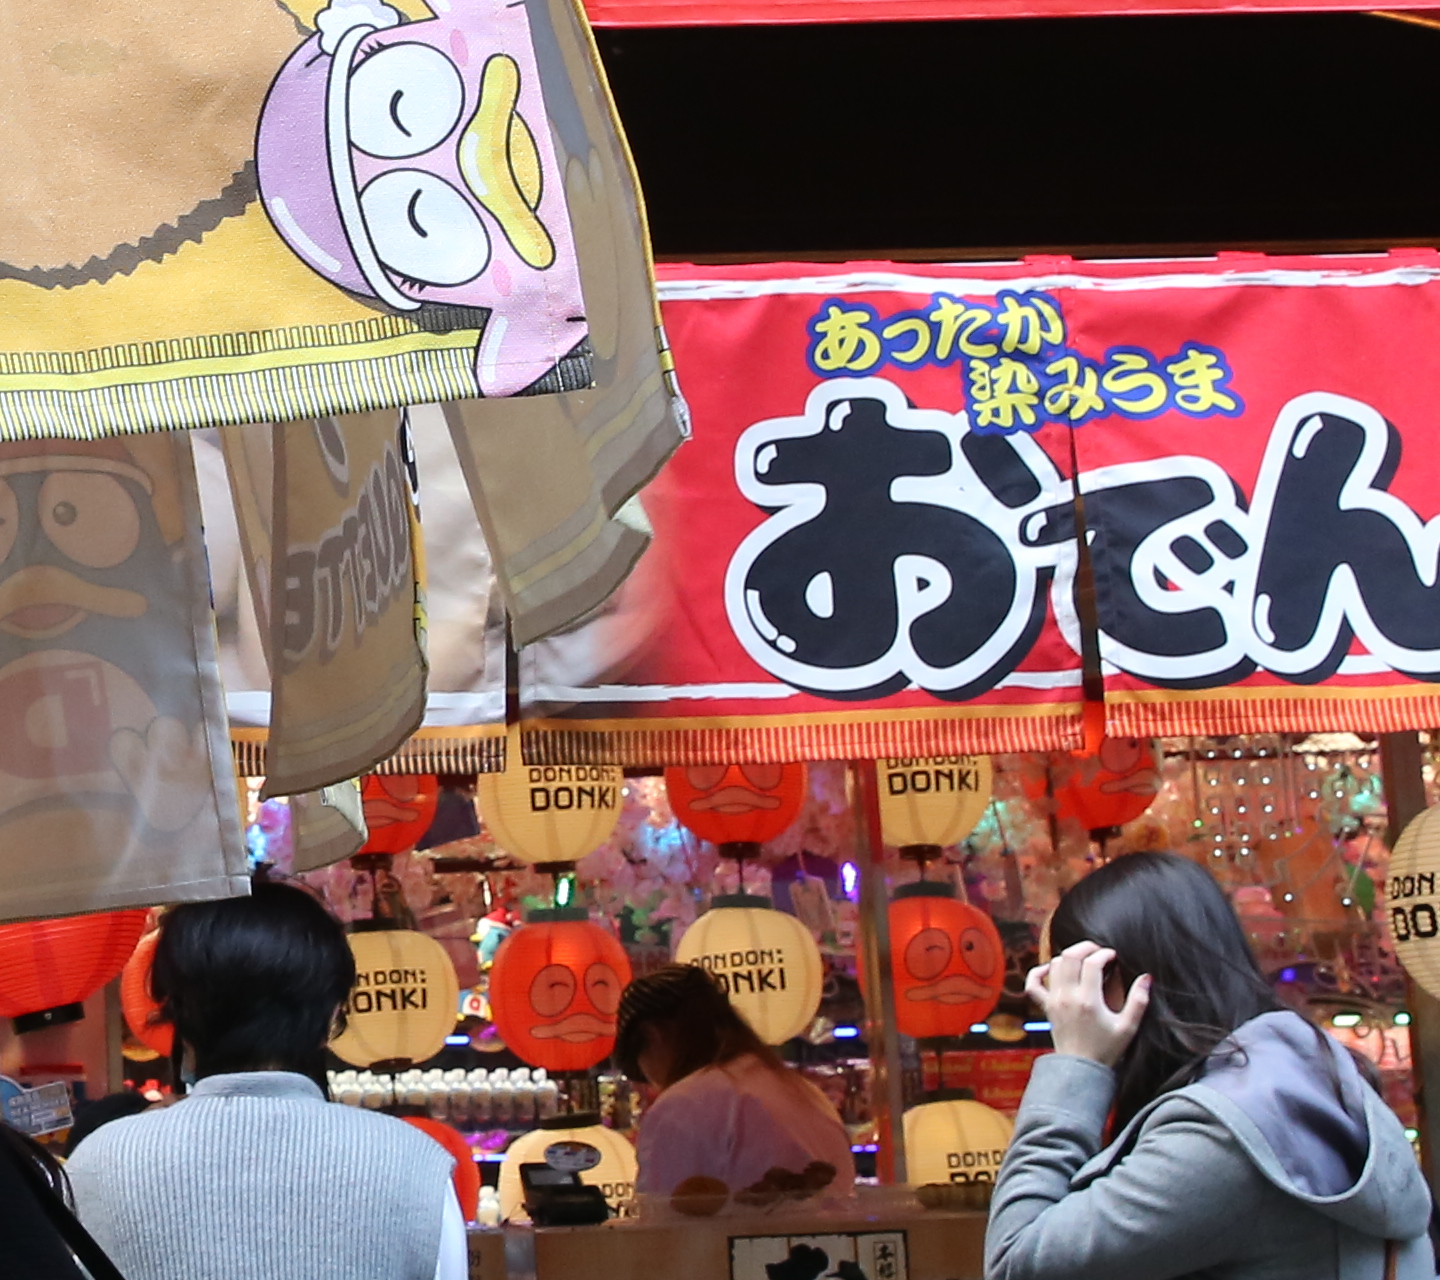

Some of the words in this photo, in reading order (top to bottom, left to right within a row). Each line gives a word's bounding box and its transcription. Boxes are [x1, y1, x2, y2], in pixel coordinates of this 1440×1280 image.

[814, 295, 1064, 375] あったか
[969, 352, 1228, 429] 染みうま
[887, 769, 979, 797] DONKI
[531, 786, 616, 811] DONKI
[347, 987, 427, 1014] ONKI
